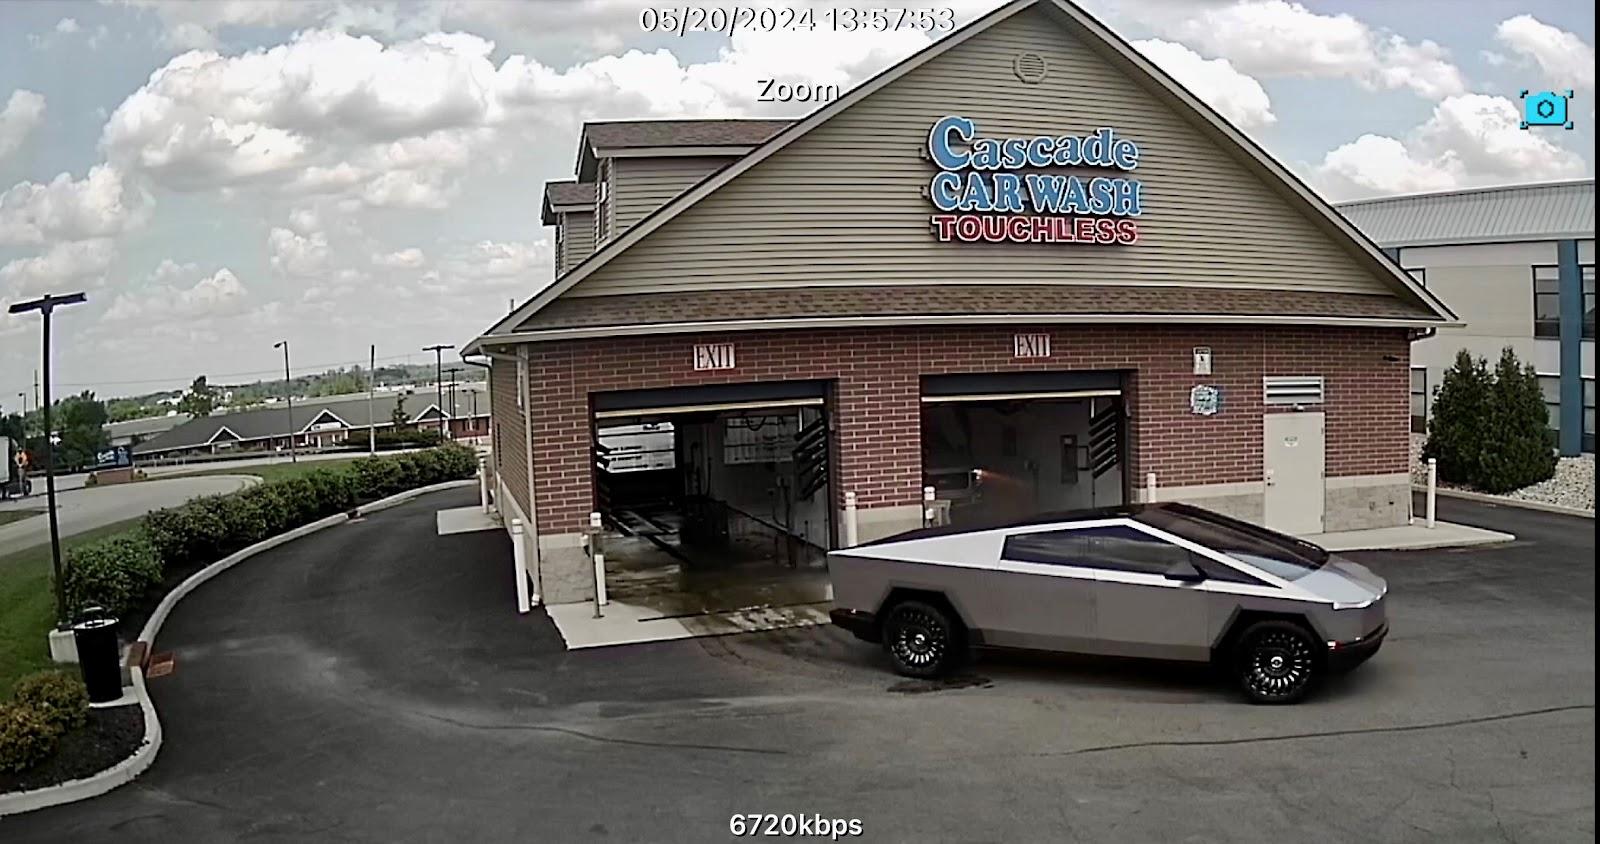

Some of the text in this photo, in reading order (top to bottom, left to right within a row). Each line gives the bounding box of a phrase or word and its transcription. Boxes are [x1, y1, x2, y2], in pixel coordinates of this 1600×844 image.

[928, 115, 1139, 171] Cascade
[931, 171, 1142, 216] CAR WASH
[932, 214, 1138, 245] TOUCHLESS
[696, 345, 732, 368] EXIT
[1016, 334, 1048, 356] EXIT
